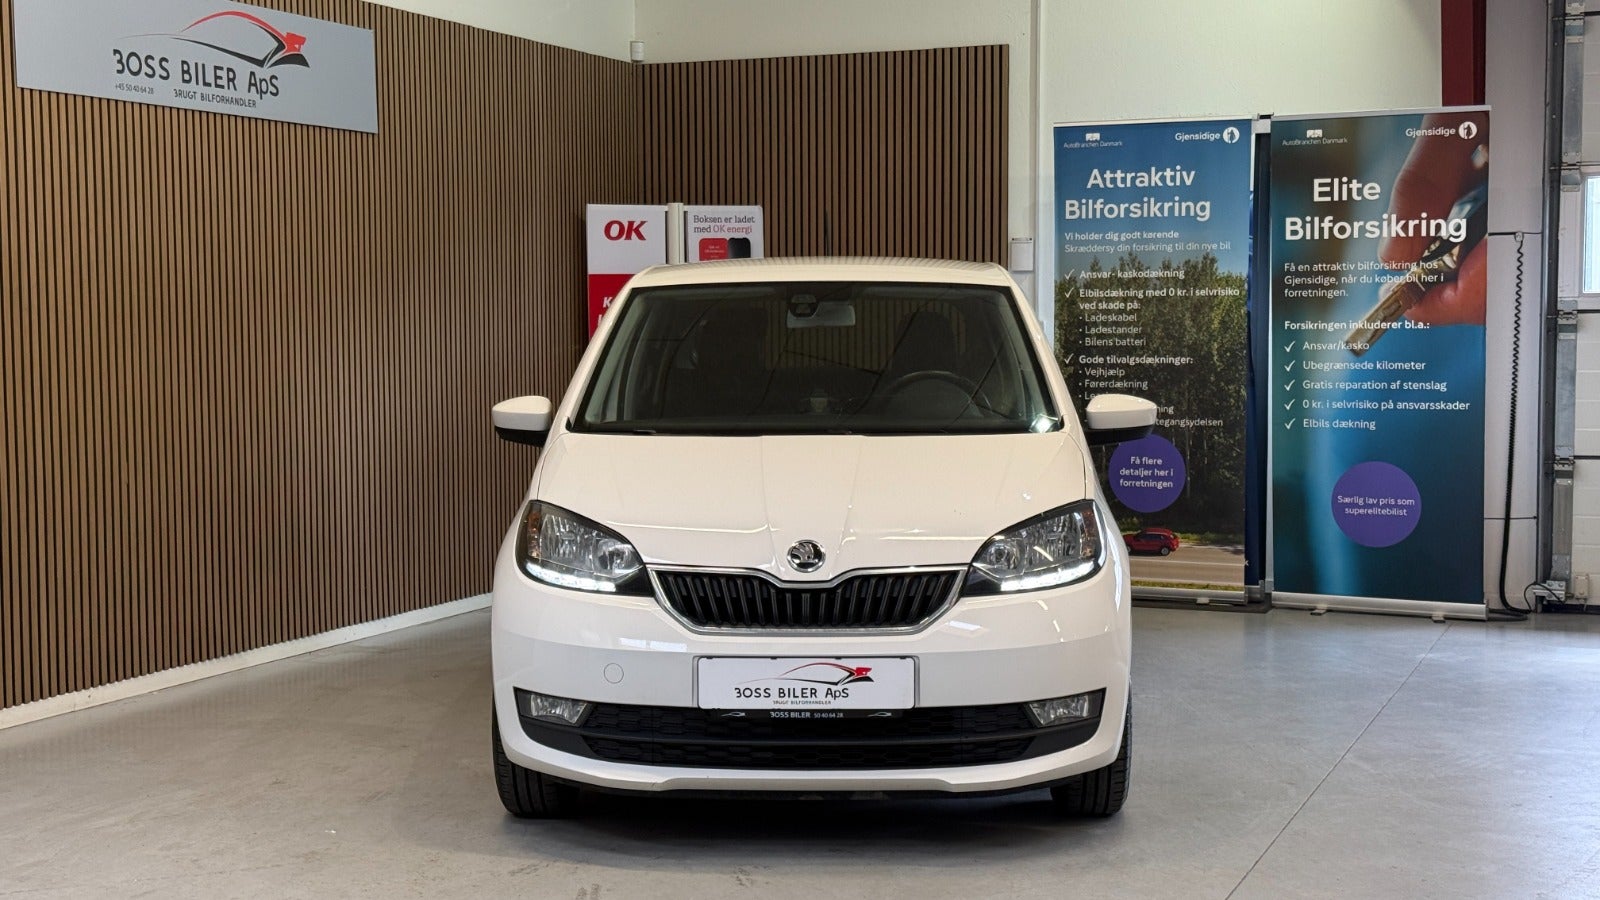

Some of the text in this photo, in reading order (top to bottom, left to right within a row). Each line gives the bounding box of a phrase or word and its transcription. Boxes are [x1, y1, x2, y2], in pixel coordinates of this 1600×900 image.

[181, 60, 237, 91] BILER
[248, 71, 279, 99] ApS
[200, 92, 256, 108] BILFORHANDLER
[1175, 132, 1221, 142] Gjensidige
[1406, 127, 1456, 137] Gjensidige
[1282, 137, 1348, 146] AutoBranchen Danmark
[1087, 165, 1196, 188] Attraktiv
[1314, 177, 1380, 202] Elite
[1065, 196, 1211, 222] Bilforsikring
[693, 215, 723, 223] Boksen
[735, 215, 755, 223] ladet
[604, 220, 648, 241] OK
[694, 225, 711, 233] med
[727, 226, 752, 235] energi
[1285, 212, 1467, 243] Bilforsikring
[1075, 232, 1102, 240] holder
[1105, 232, 1119, 242] dig
[1121, 232, 1141, 241] godt
[1143, 231, 1179, 239] kørende
[1065, 244, 1114, 253] Skræddersy
[1132, 243, 1173, 253] forsikring
[1220, 242, 1231, 250] bil
[1284, 263, 1295, 272] Få
[1312, 263, 1355, 271] attraktiv
[1358, 261, 1417, 271] bilforsikring
[1420, 261, 1438, 269] hos
[1079, 268, 1185, 279] Ansvar- kaskodækning
[1284, 275, 1338, 286] Gjensidige,
[1342, 275, 1357, 283] når
[1360, 275, 1372, 283] du
[1375, 274, 1403, 283] køber
[1406, 274, 1418, 282] bil
[1421, 274, 1438, 282] her
[1079, 288, 1144, 299] Elbilsdækning
[1146, 288, 1166, 297] med
[1168, 288, 1174, 296] 0
[1177, 288, 1188, 296] kr.
[1195, 287, 1240, 296] selvrisiko
[1284, 289, 1348, 298] forretningen.
[1079, 301, 1141, 311] ved skade på:
[1085, 313, 1137, 322] Ladeskabel
[1085, 325, 1142, 334] Ladestander
[1284, 320, 1430, 331] Forsikringen inkluderer bl.a.:
[1085, 338, 1146, 347] Bilens batteri
[1303, 341, 1370, 351] Ansvar/kasko
[1079, 355, 1193, 366] Gode tilvalgsdækninger:
[1303, 360, 1426, 371] Ubegrænsede kilometer
[1085, 367, 1125, 377] Vejhjælp
[1085, 379, 1148, 390] Førerdækning
[1302, 380, 1447, 392] Gratis reparation af stenslag
[1302, 400, 1309, 409] 0
[1312, 400, 1324, 409] kr.
[1332, 400, 1379, 409] selvrisiko
[1381, 401, 1394, 411] på
[1396, 401, 1470, 411] ansvarsskader
[1155, 418, 1223, 428] tegangsydelsen
[1303, 419, 1376, 430] Elbils dækning
[1131, 457, 1162, 465] Få flere
[1120, 468, 1152, 478] detaljer
[1154, 468, 1168, 476] her
[1120, 479, 1173, 489] forretningen
[1337, 495, 1364, 505] Særlig
[1380, 497, 1395, 506] pris
[1345, 508, 1407, 516] superelitebilist
[779, 688, 818, 698] BILER
[825, 688, 849, 700] ApS
